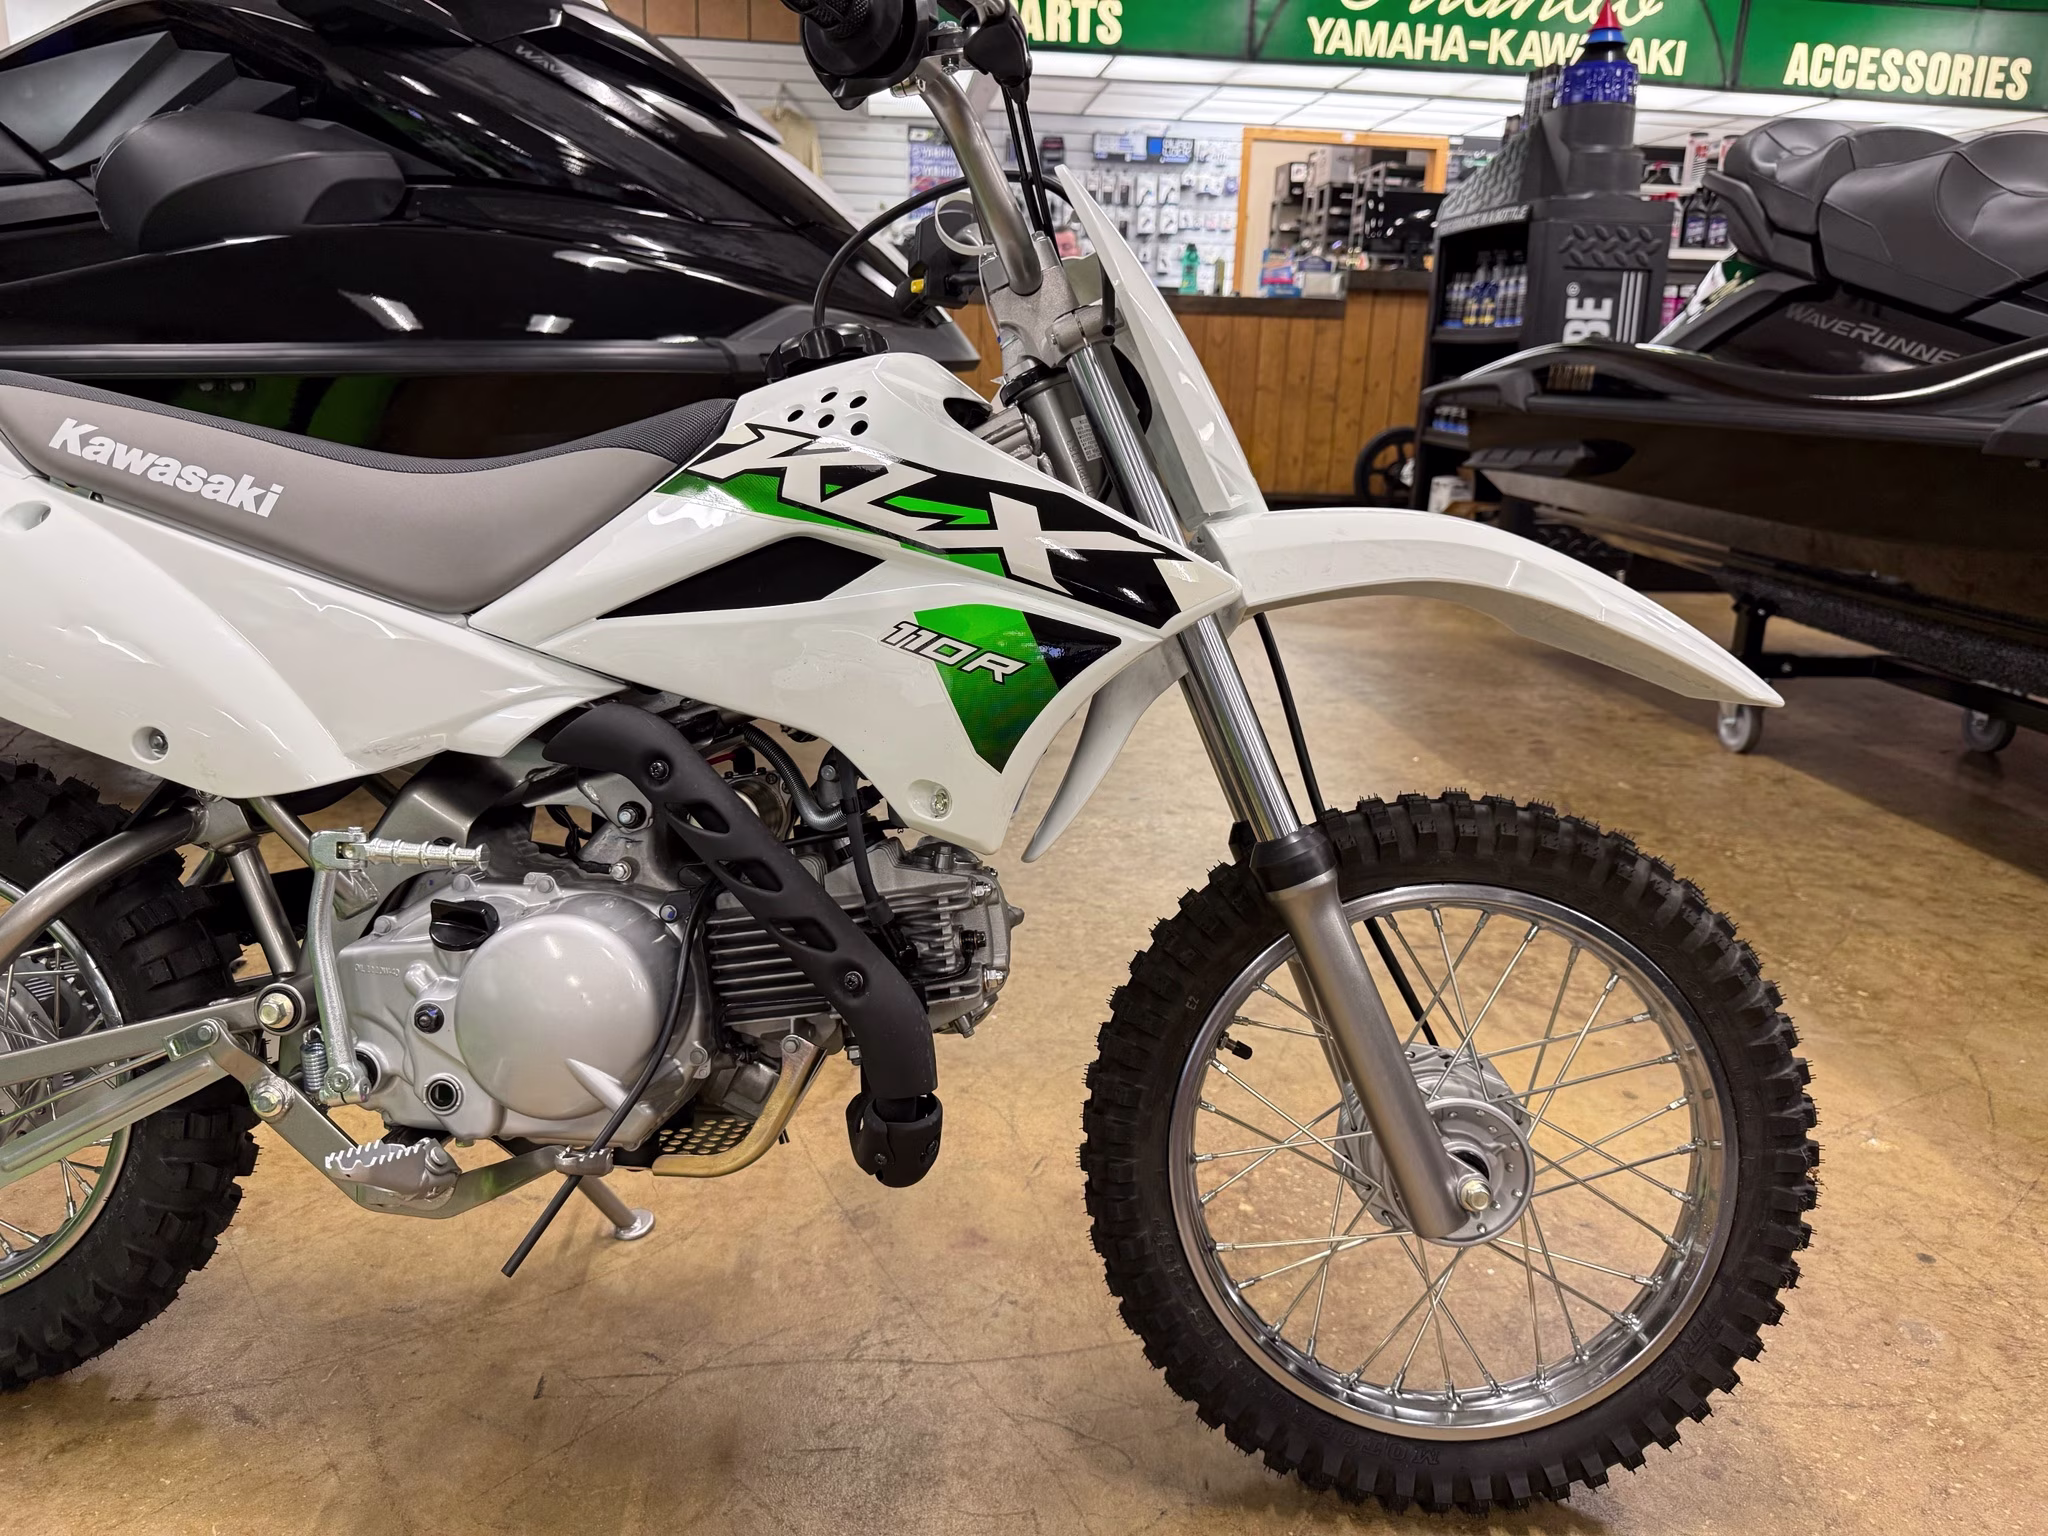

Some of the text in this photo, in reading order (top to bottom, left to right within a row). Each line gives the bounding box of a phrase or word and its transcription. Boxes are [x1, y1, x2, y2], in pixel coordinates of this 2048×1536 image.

[1013, 0, 1123, 45] ARTS
[1307, 16, 1688, 76] YAMAHA-KAWAKI
[1783, 42, 2032, 100] ACCESSORIES
[1785, 303, 1961, 364] WAVERUNNE
[49, 418, 285, 517] Kawasaki
[686, 424, 1168, 597] KLX
[879, 621, 1031, 684] 110R
[1184, 995, 1200, 1011] E2
